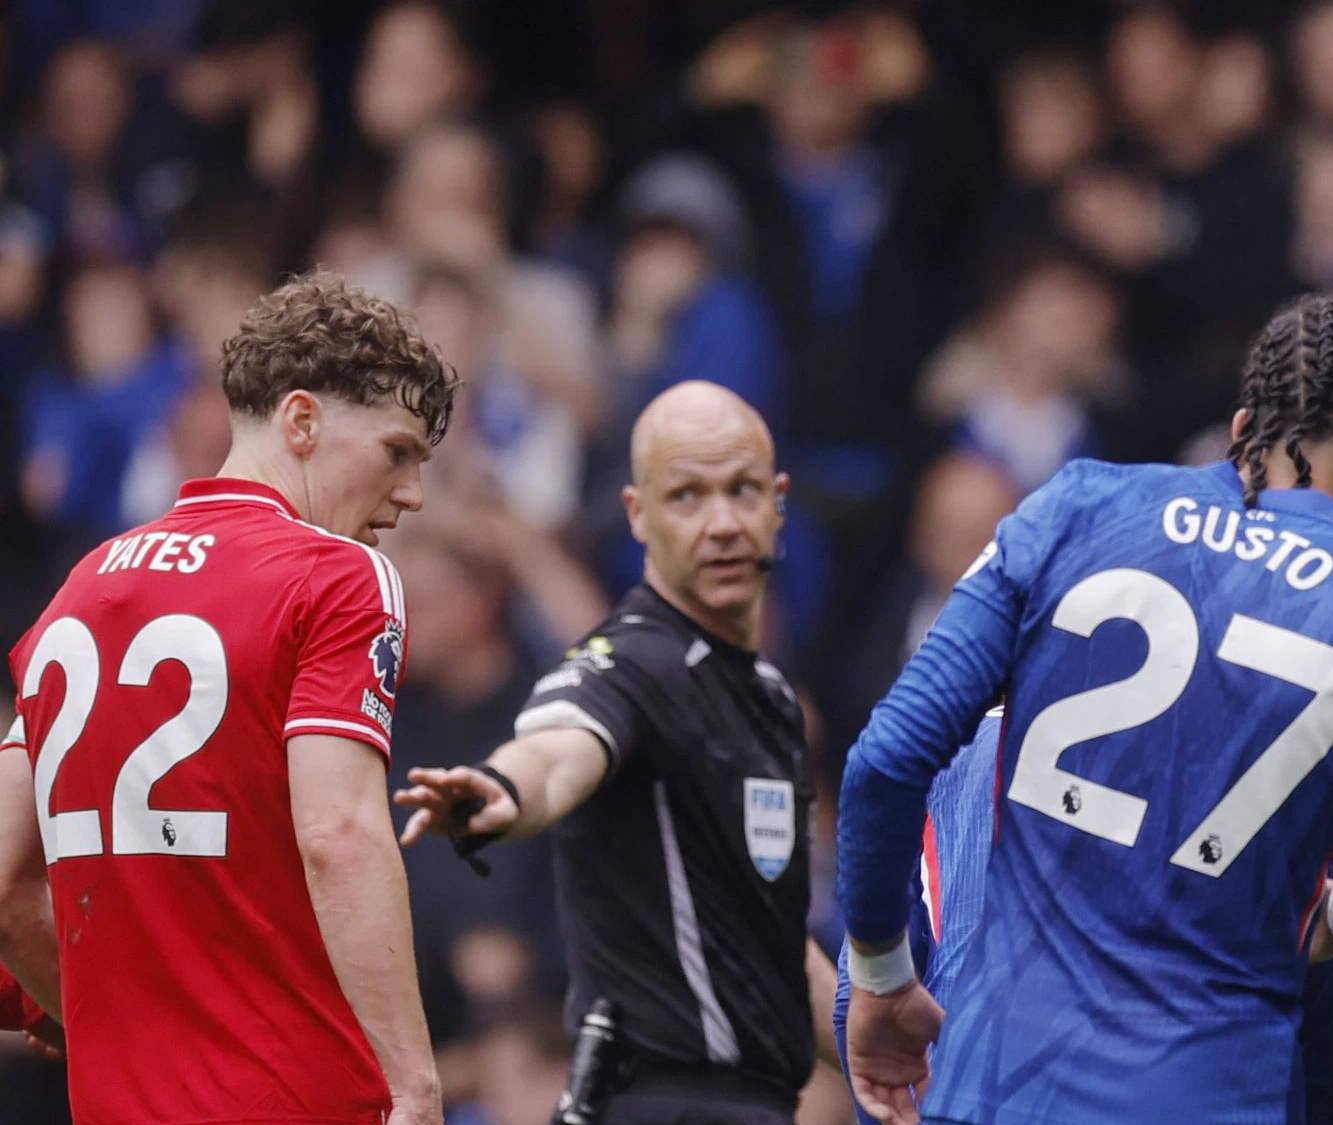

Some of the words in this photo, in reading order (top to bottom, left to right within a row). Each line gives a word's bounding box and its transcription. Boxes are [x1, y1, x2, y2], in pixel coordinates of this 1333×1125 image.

[1163, 497, 1333, 590] GUSTO
[1246, 509, 1276, 522] CFC
[97, 532, 216, 575] YATES
[22, 613, 230, 866] 22
